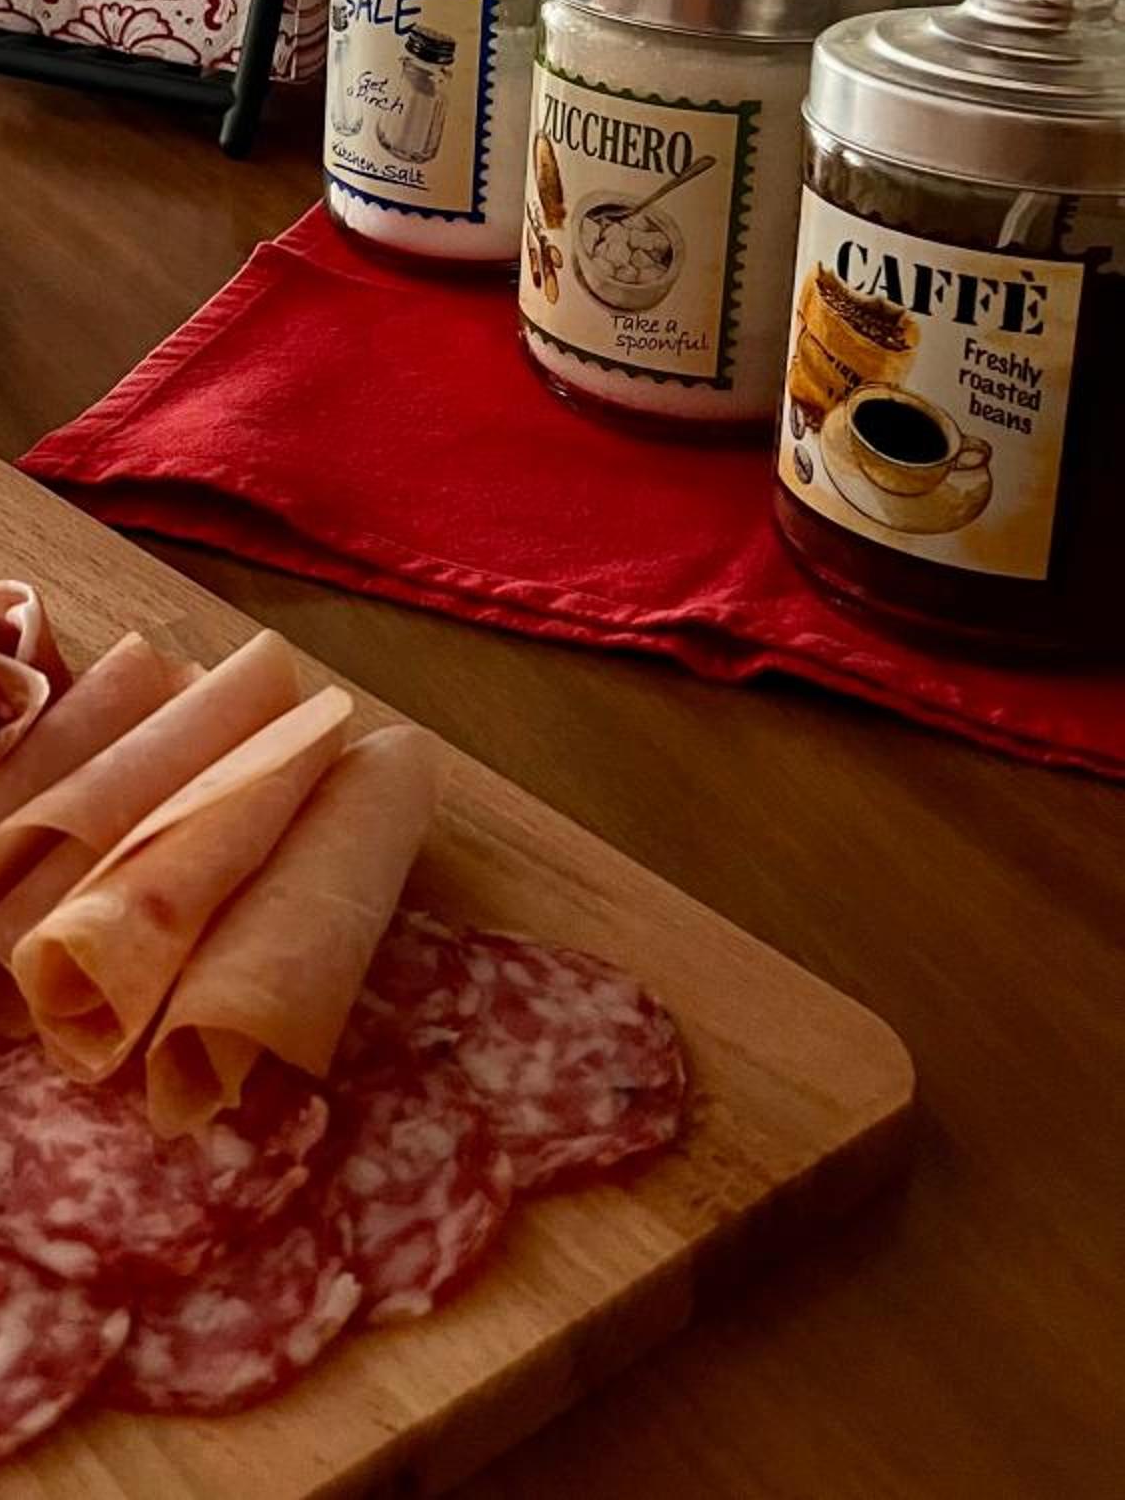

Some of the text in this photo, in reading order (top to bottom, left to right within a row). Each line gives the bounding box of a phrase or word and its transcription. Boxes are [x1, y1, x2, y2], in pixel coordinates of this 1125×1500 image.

[357, 71, 388, 94] Get
[540, 94, 694, 179] ZUCCHERO
[836, 240, 1049, 336] CAFFÈ
[610, 314, 679, 333] Take a
[614, 331, 711, 356] spoonful
[963, 337, 1043, 390] Freshly
[958, 368, 1042, 413] roasted
[968, 393, 1033, 436] beans
